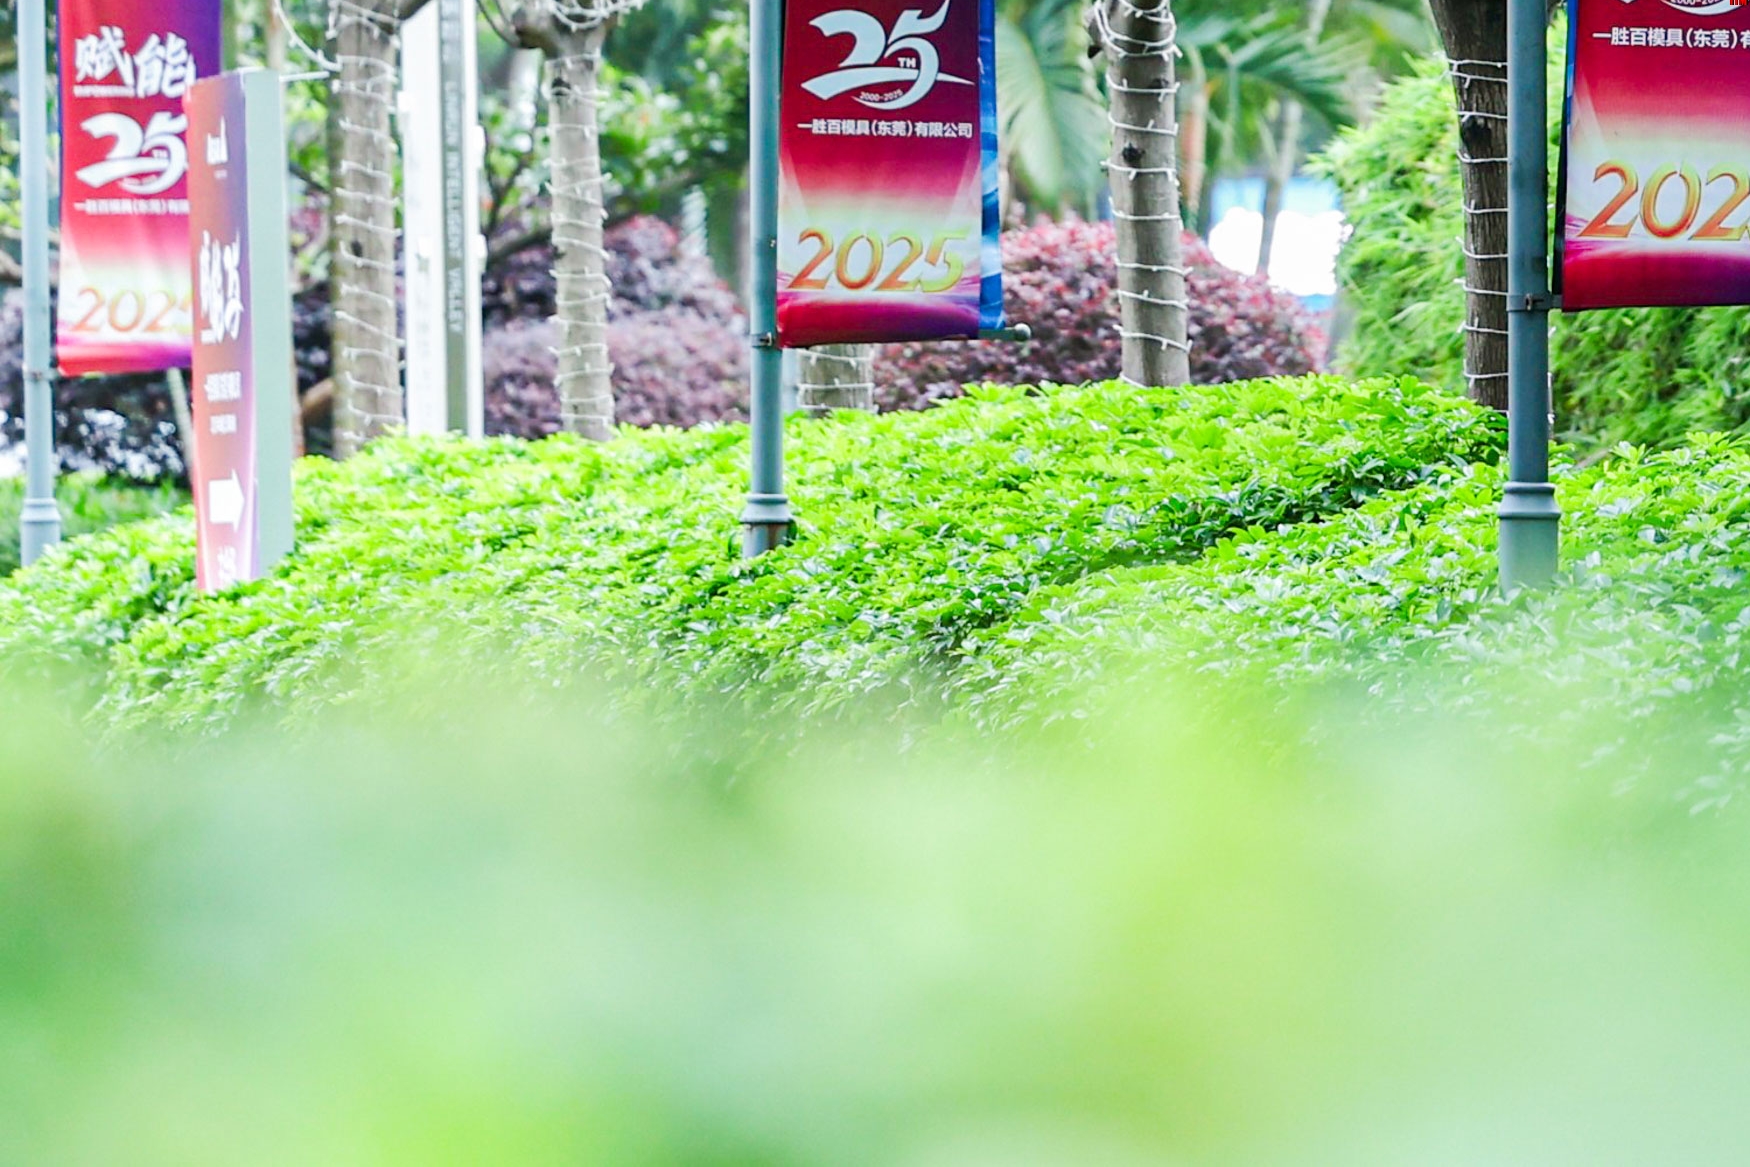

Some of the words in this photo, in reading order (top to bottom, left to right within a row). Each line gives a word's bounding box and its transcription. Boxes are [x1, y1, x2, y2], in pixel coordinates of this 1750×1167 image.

[75, 25, 196, 98] 赋能
[898, 57, 916, 68] TH
[786, 226, 971, 293] 2025
